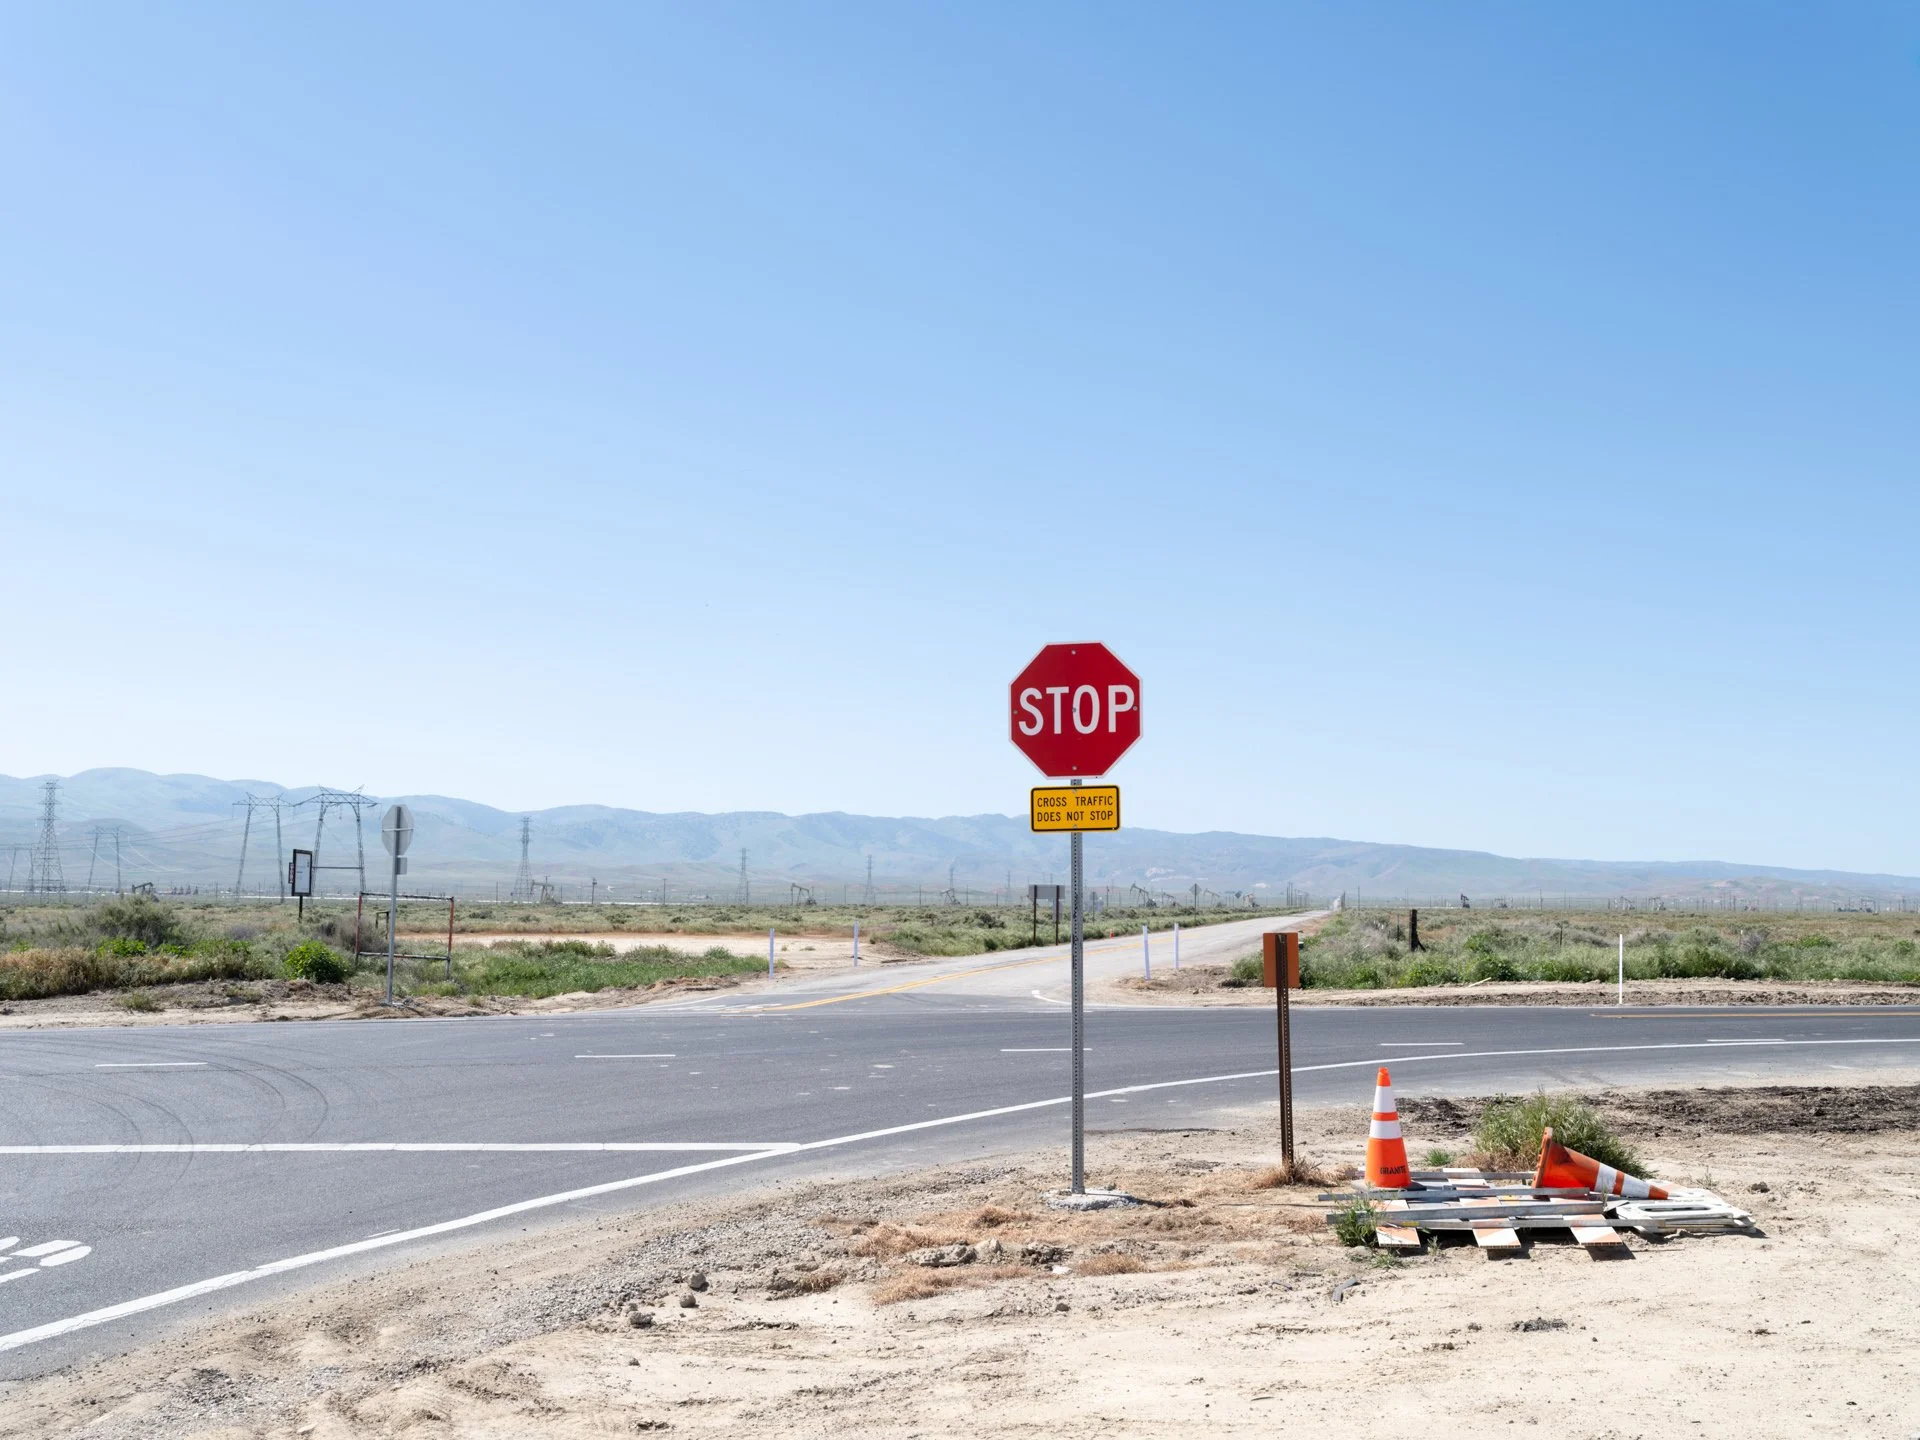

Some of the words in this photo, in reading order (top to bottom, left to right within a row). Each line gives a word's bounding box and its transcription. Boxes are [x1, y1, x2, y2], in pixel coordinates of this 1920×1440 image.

[1018, 684, 1135, 736] STOP
[1037, 797, 1067, 807] CROSS
[1075, 796, 1113, 806] TRAFFIC
[1037, 811, 1061, 822] DOES
[1066, 811, 1085, 821] NOT
[1089, 810, 1114, 821] STOP
